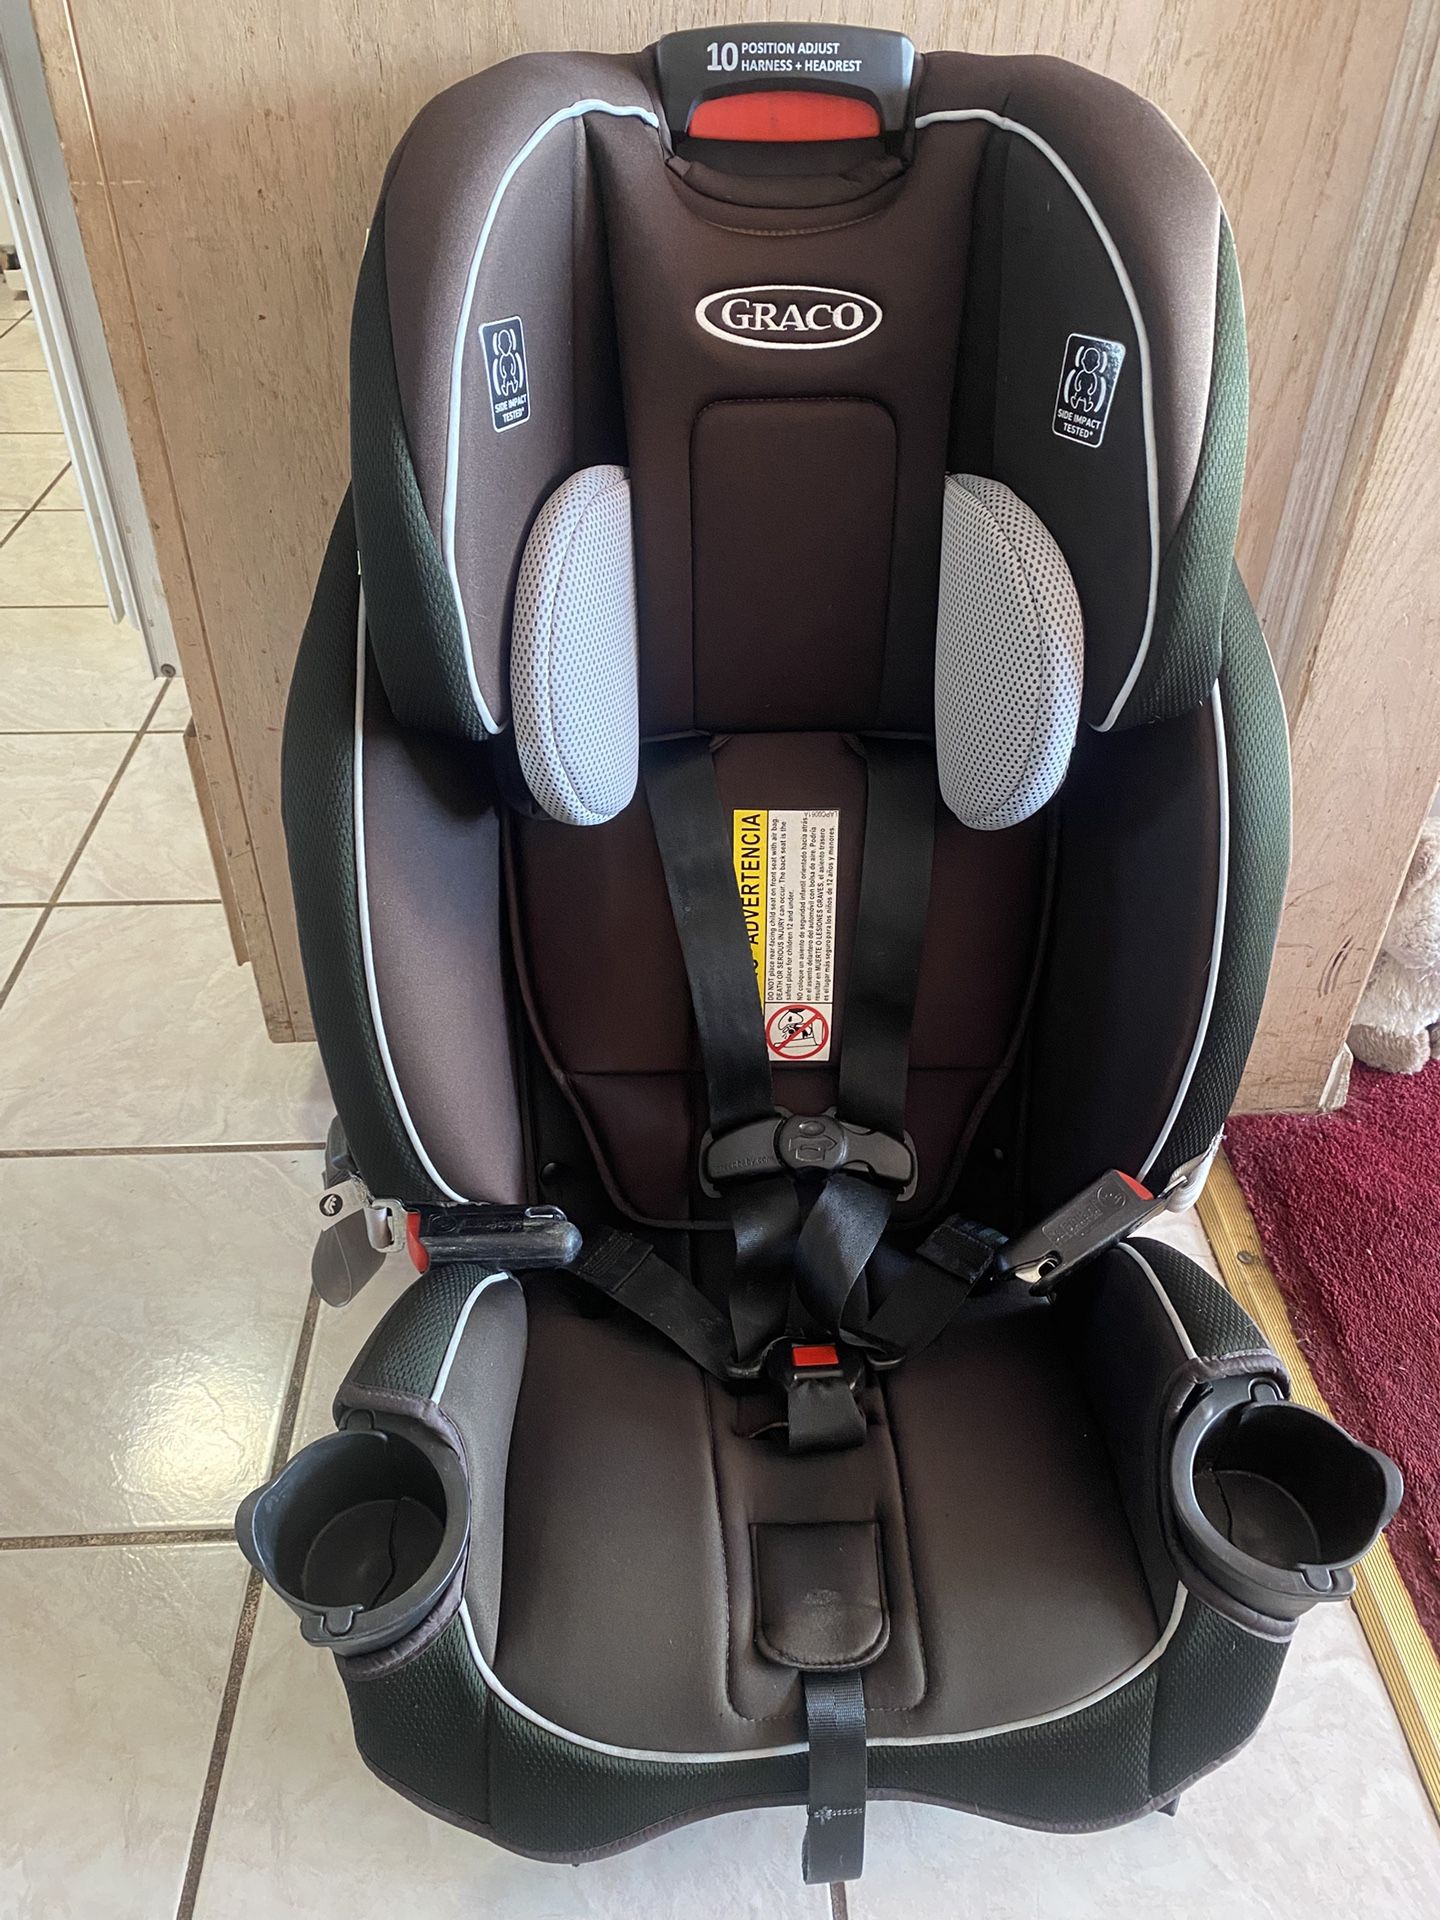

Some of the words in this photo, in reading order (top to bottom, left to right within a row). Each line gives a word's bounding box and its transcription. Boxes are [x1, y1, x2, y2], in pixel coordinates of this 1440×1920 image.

[741, 42, 795, 54] POSITION
[797, 42, 840, 54] ADJUST
[706, 42, 739, 71] 10
[741, 60, 793, 72] HARNESS
[804, 60, 862, 72] HEADREST
[721, 298, 865, 331] GRACO
[495, 400, 509, 413] SIDE
[1057, 408, 1073, 421] SIDE
[1073, 413, 1101, 430] IMPACT
[741, 814, 760, 945] ADVERTENCIA
[771, 888, 776, 896] on
[769, 928, 777, 959] rear-facing
[777, 970, 783, 979] OR
[768, 992, 774, 1000] DO
[797, 992, 803, 1000] NO
